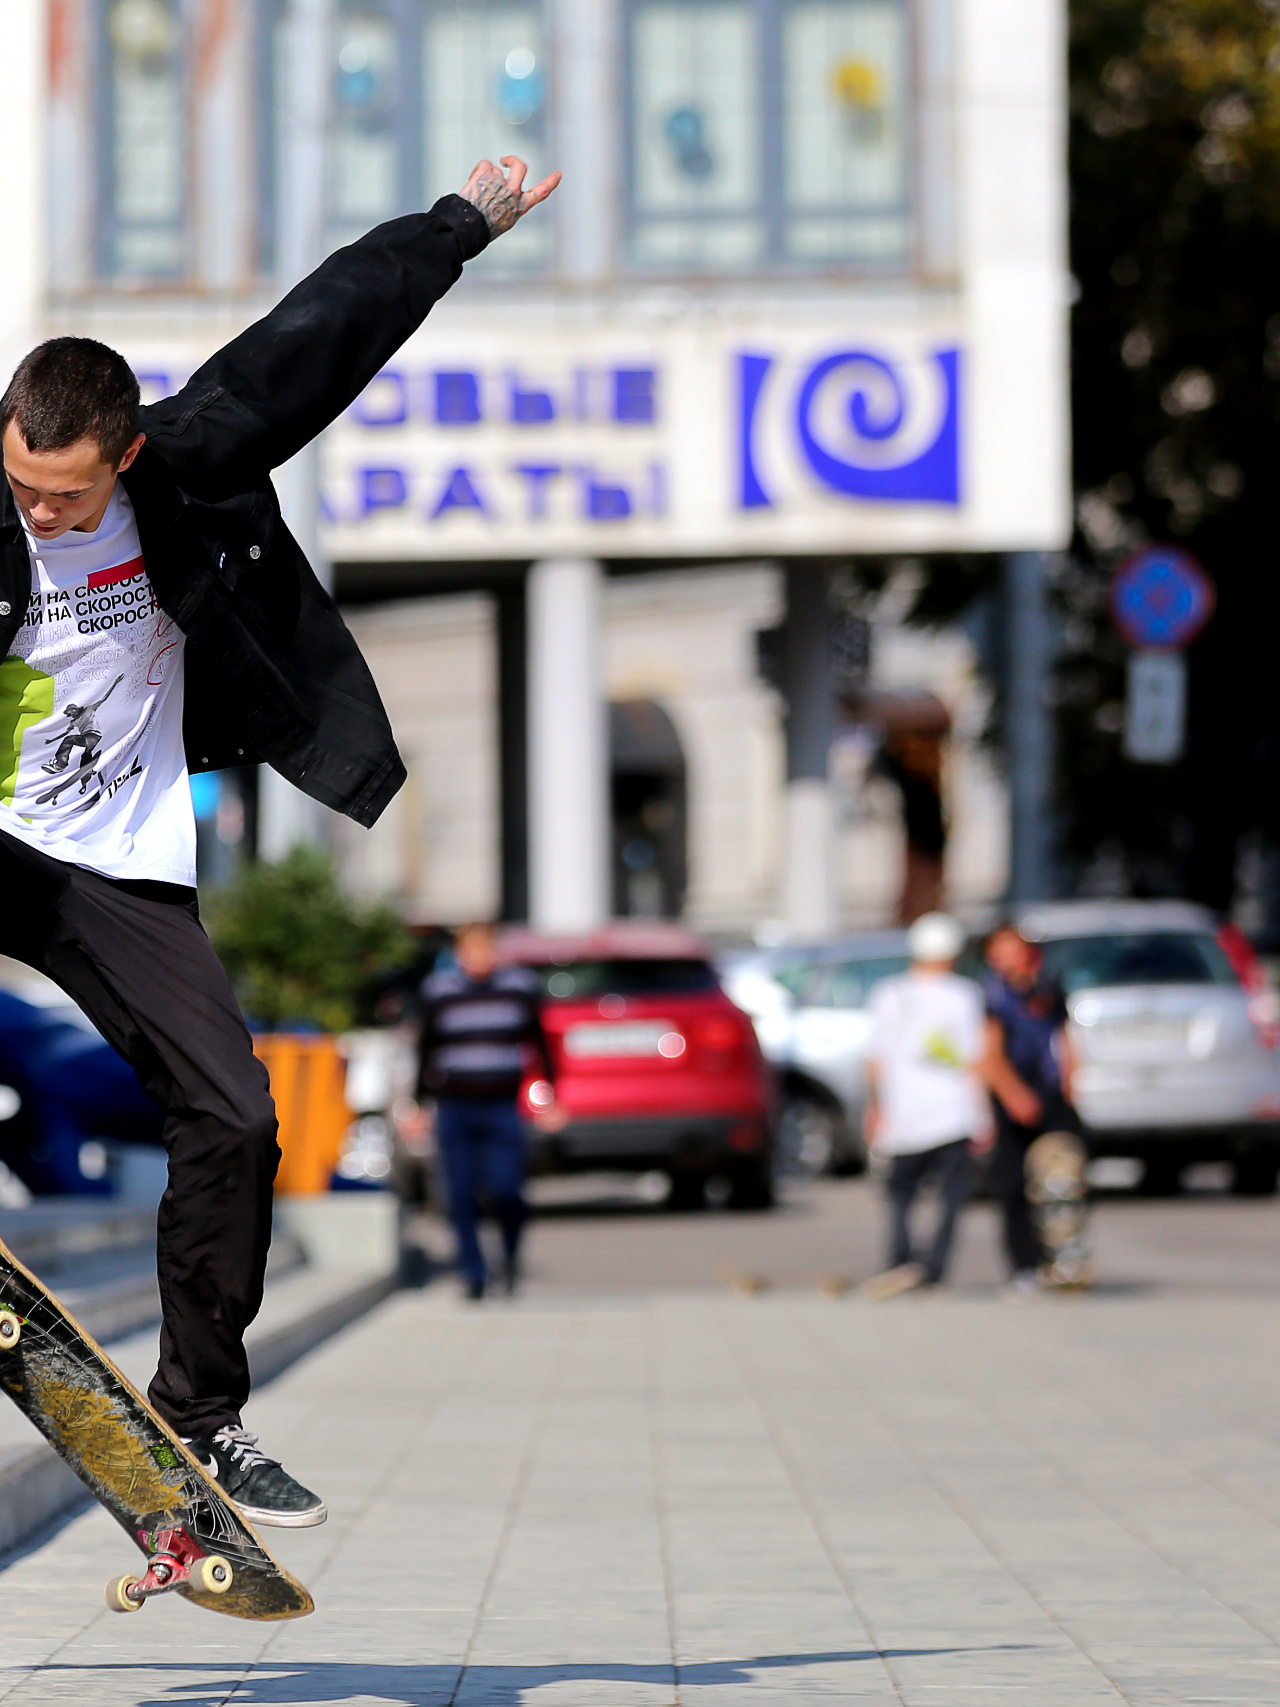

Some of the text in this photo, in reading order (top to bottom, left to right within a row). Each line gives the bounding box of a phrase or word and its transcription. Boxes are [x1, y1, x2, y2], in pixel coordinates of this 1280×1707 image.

[47, 590, 71, 605] НА
[47, 605, 72, 623] НА
[77, 600, 160, 635] СКОРОСТ
